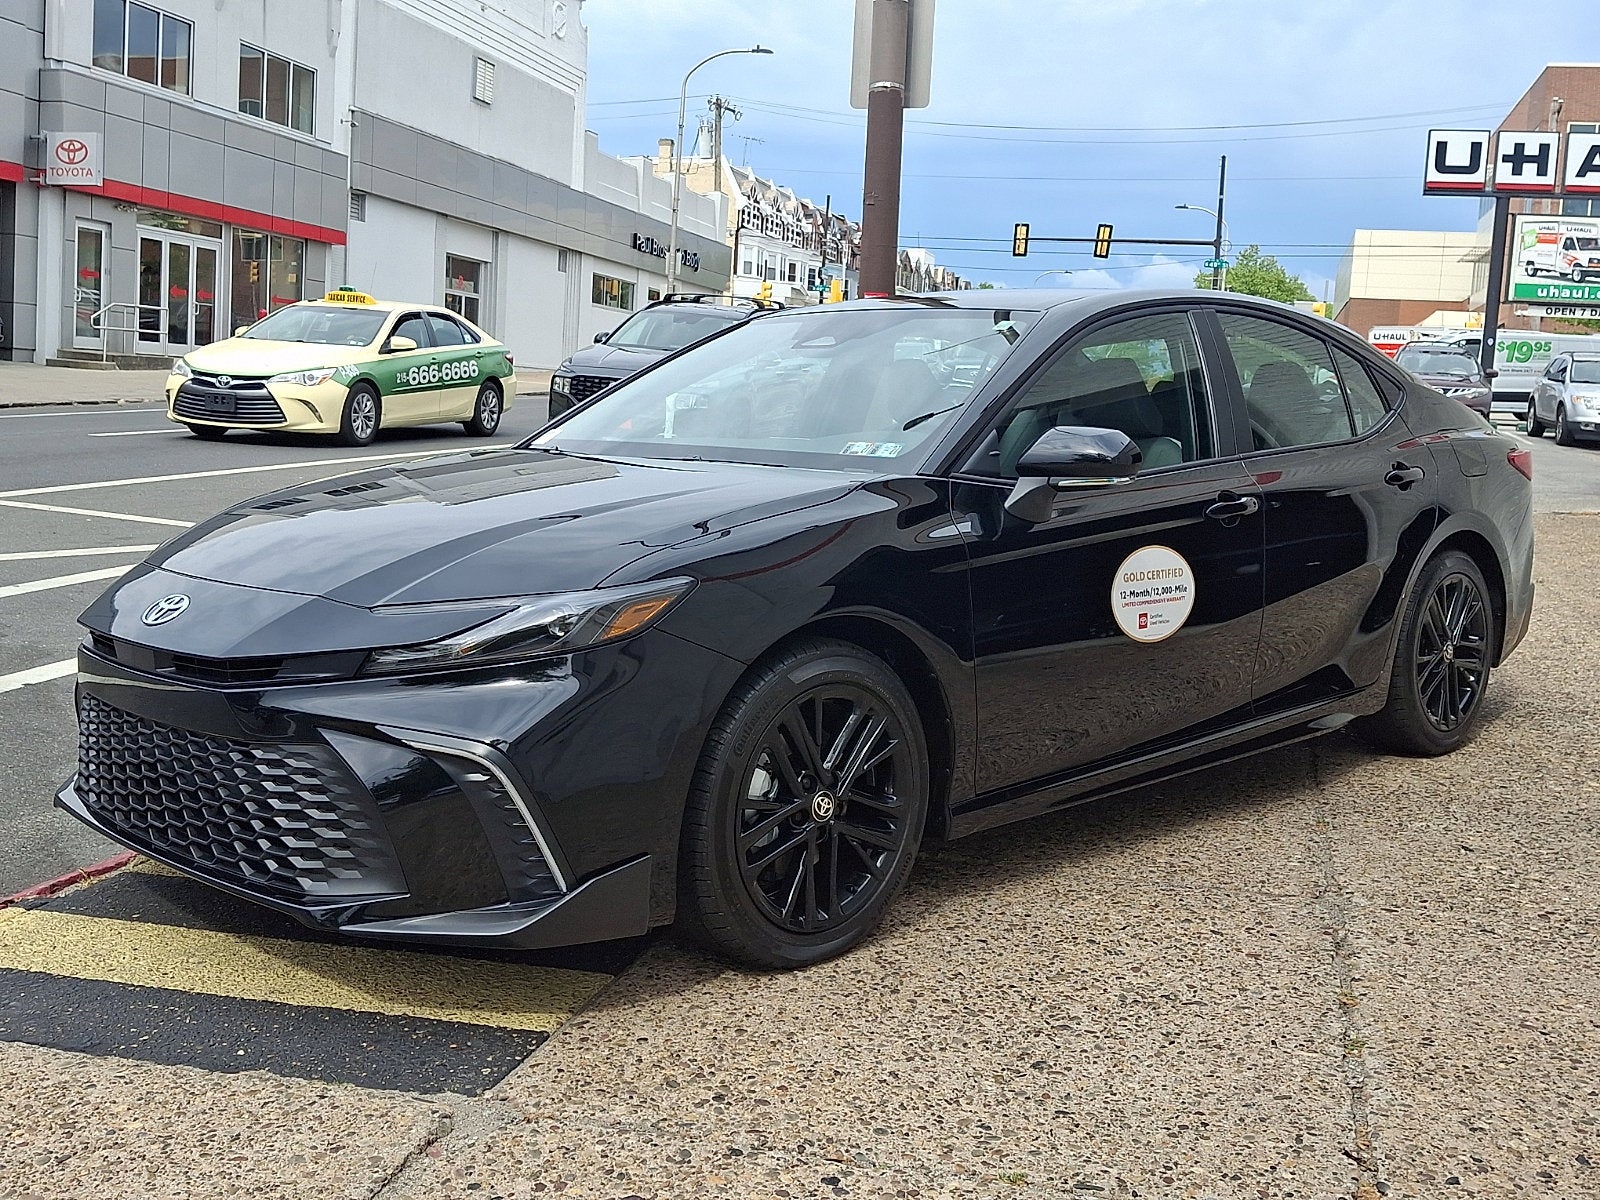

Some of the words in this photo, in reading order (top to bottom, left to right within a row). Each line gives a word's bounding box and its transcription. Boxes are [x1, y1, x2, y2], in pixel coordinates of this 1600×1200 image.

[49, 167, 93, 177] TOYOTA
[633, 233, 652, 253] Paul
[685, 249, 701, 273] Body
[346, 294, 367, 304] SERVICE
[1545, 307, 1577, 316] OPEN
[1580, 308, 1587, 316] 7
[1590, 309, 1600, 317] D
[1123, 571, 1146, 583] GOLD
[1146, 567, 1184, 581] CERTIFIED
